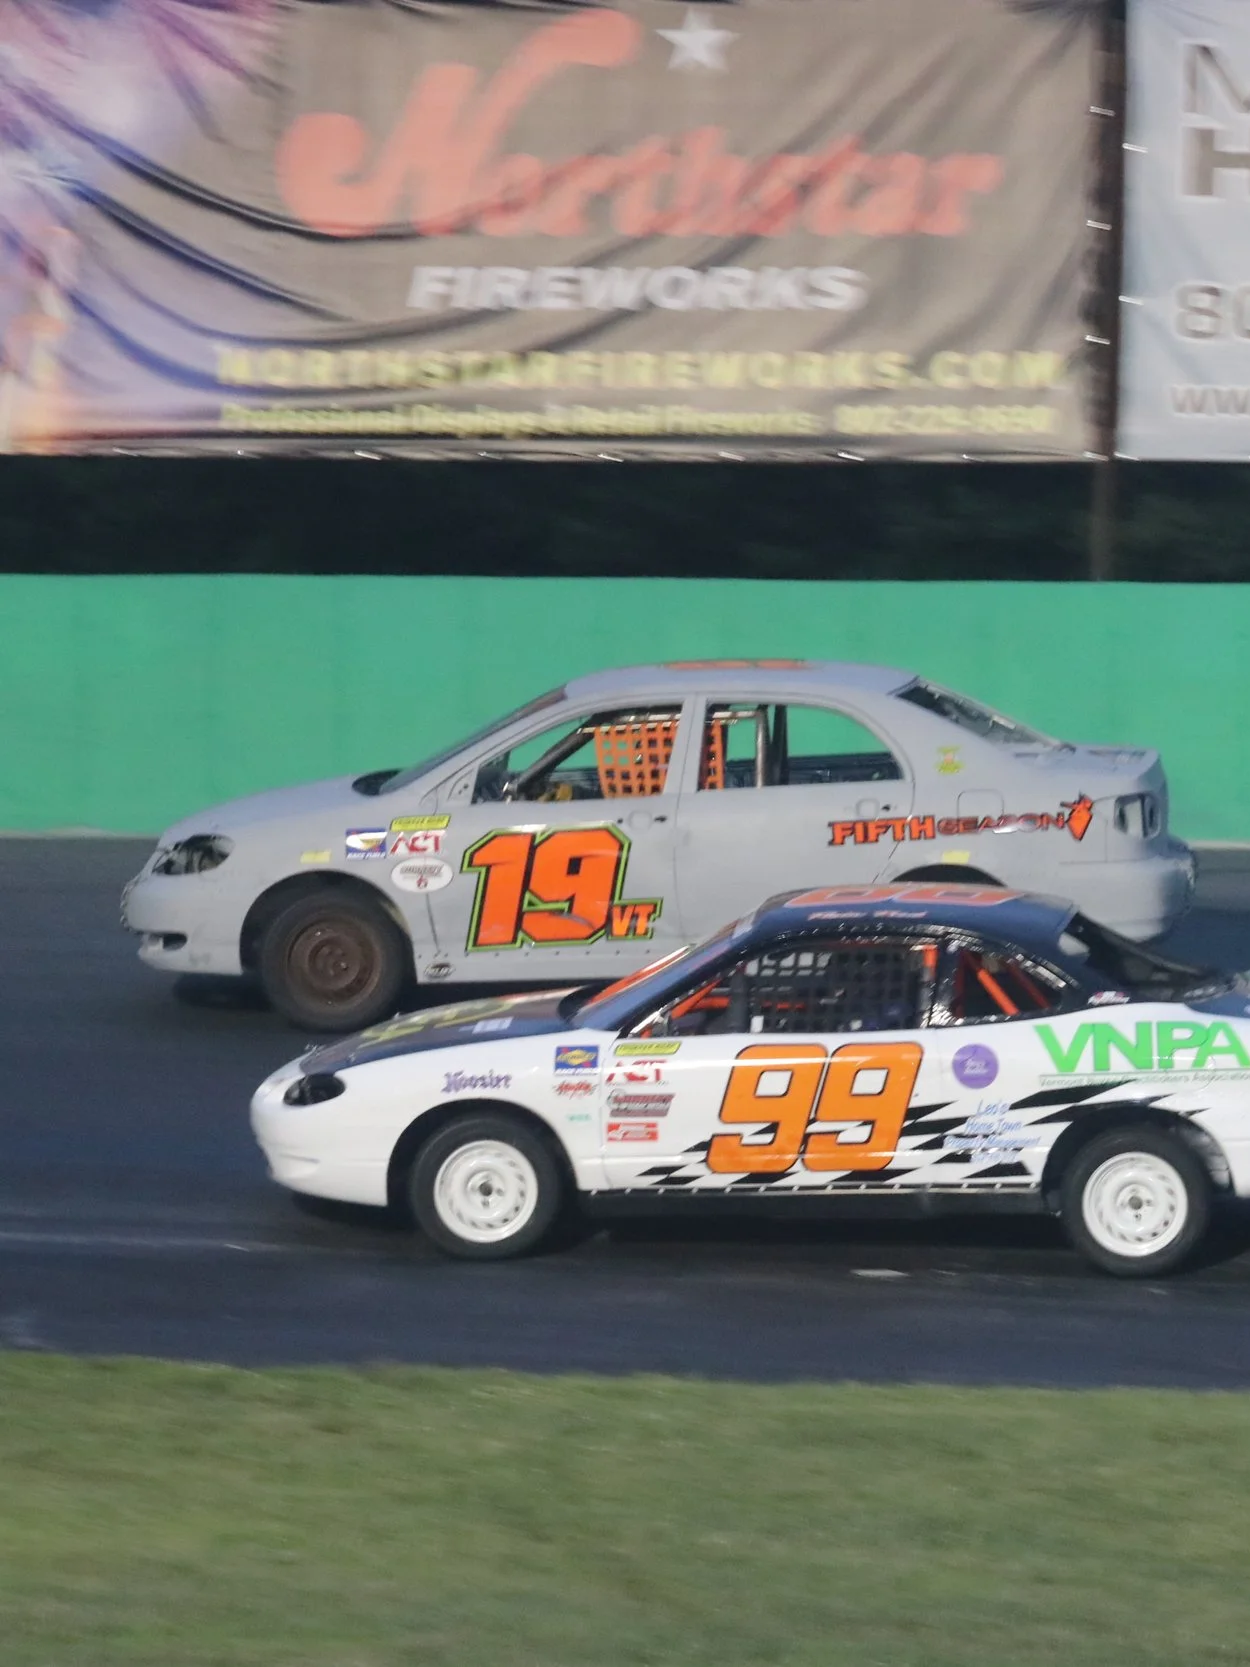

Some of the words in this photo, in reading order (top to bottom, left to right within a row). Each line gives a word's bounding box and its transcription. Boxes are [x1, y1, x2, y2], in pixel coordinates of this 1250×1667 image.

[408, 265, 868, 311] FIREWORKS
[827, 815, 936, 846] FIFTH
[460, 821, 633, 953] 19
[609, 897, 664, 940] VT
[706, 1042, 924, 1174] 99
